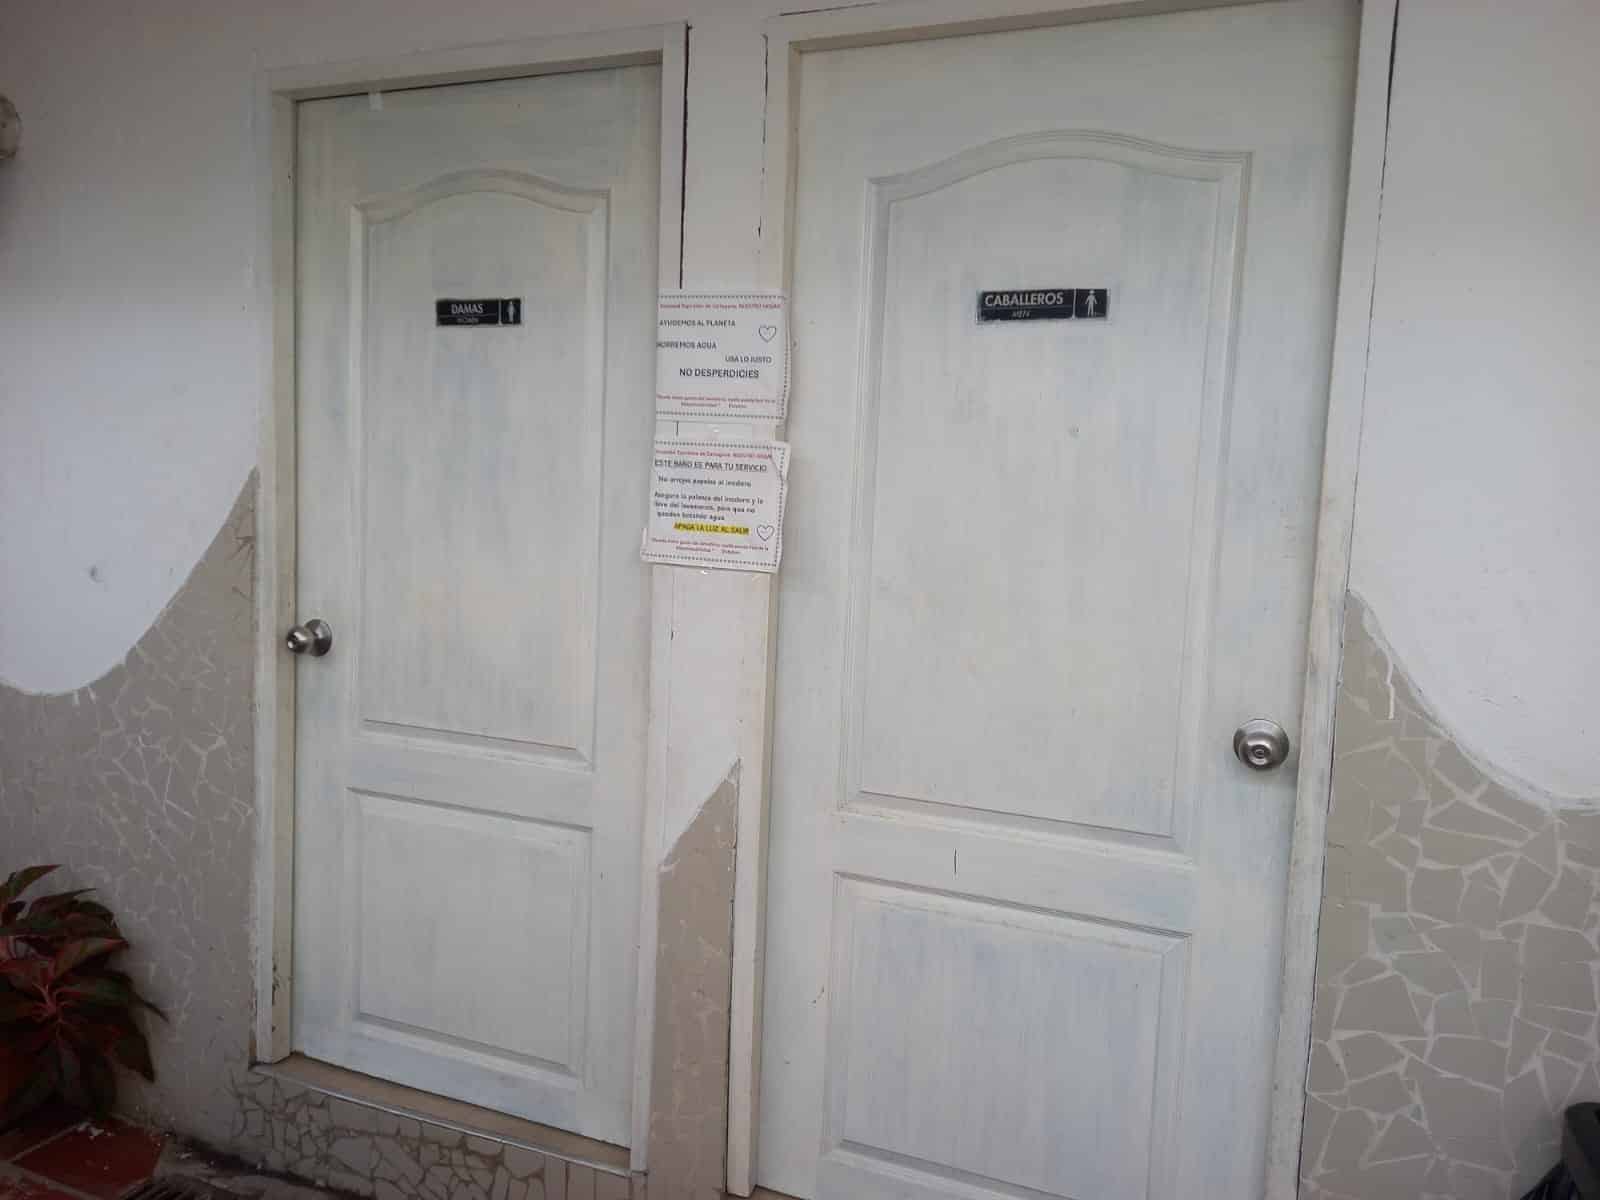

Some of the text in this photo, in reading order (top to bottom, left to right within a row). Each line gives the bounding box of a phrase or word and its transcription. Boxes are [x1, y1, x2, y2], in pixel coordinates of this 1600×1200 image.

[985, 291, 1064, 307] CABALLEROS
[451, 303, 484, 315] DAMAS
[659, 319, 736, 328] AYUDEMOS AL PLANETA
[696, 341, 717, 350] AGUA
[725, 355, 773, 364] USA LO JUSTO
[679, 368, 760, 379] NO DESPERDICIES
[654, 459, 671, 468] ESTE
[694, 461, 705, 470] ES
[705, 461, 723, 471] PARA
[724, 462, 734, 471] TU
[735, 463, 768, 473] SERVICIO
[673, 522, 750, 535] APAGA LA LUZ AL SALIR
